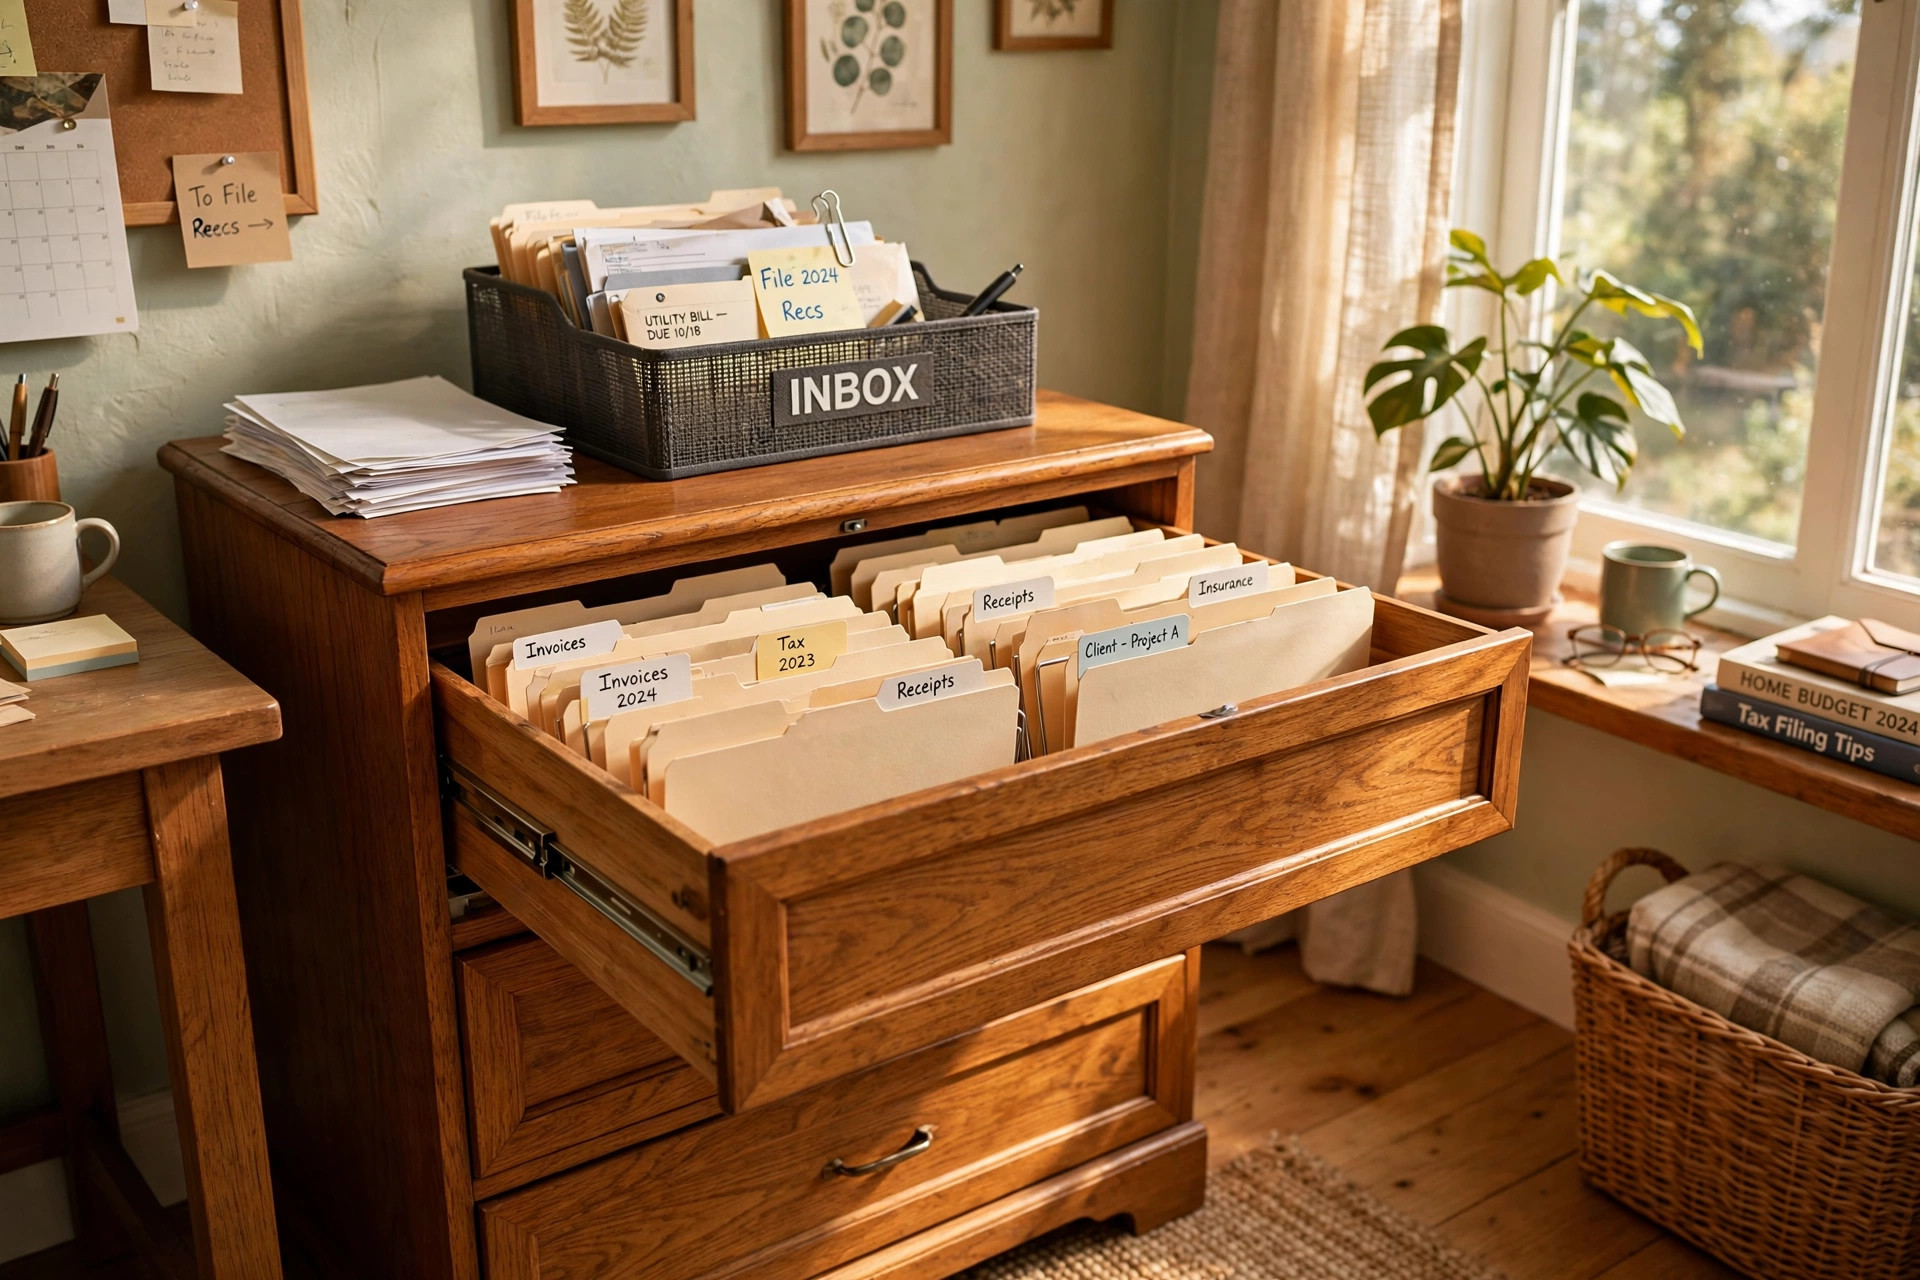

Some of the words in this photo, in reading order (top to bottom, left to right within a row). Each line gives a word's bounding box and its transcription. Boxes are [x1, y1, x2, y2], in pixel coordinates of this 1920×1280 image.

[189, 185, 213, 208] To
[223, 183, 258, 204] File
[760, 267, 794, 289] File
[801, 267, 839, 284] 2024
[645, 312, 686, 327] UTILITY
[690, 310, 713, 323] BILL
[782, 300, 824, 321] Recs
[647, 329, 670, 341] DUE
[790, 363, 919, 416] INBOX
[1198, 574, 1254, 597] Insurance
[982, 589, 1034, 611] Receipts
[525, 637, 586, 659] Invoices
[777, 635, 805, 652] Tax
[1085, 640, 1118, 659] Client
[1131, 629, 1168, 651] Project
[1171, 625, 1179, 639] A
[779, 653, 815, 672] 2023
[598, 667, 669, 692] Invoices
[897, 674, 955, 700] Receipts
[617, 687, 658, 709] 2024
[1740, 670, 1793, 700] HOME
[1797, 686, 1872, 722] BUDGET
[1875, 710, 1919, 737] 2024
[1738, 702, 1771, 731] Tax
[1775, 714, 1829, 752] Filing
[1834, 731, 1876, 762] Tips
